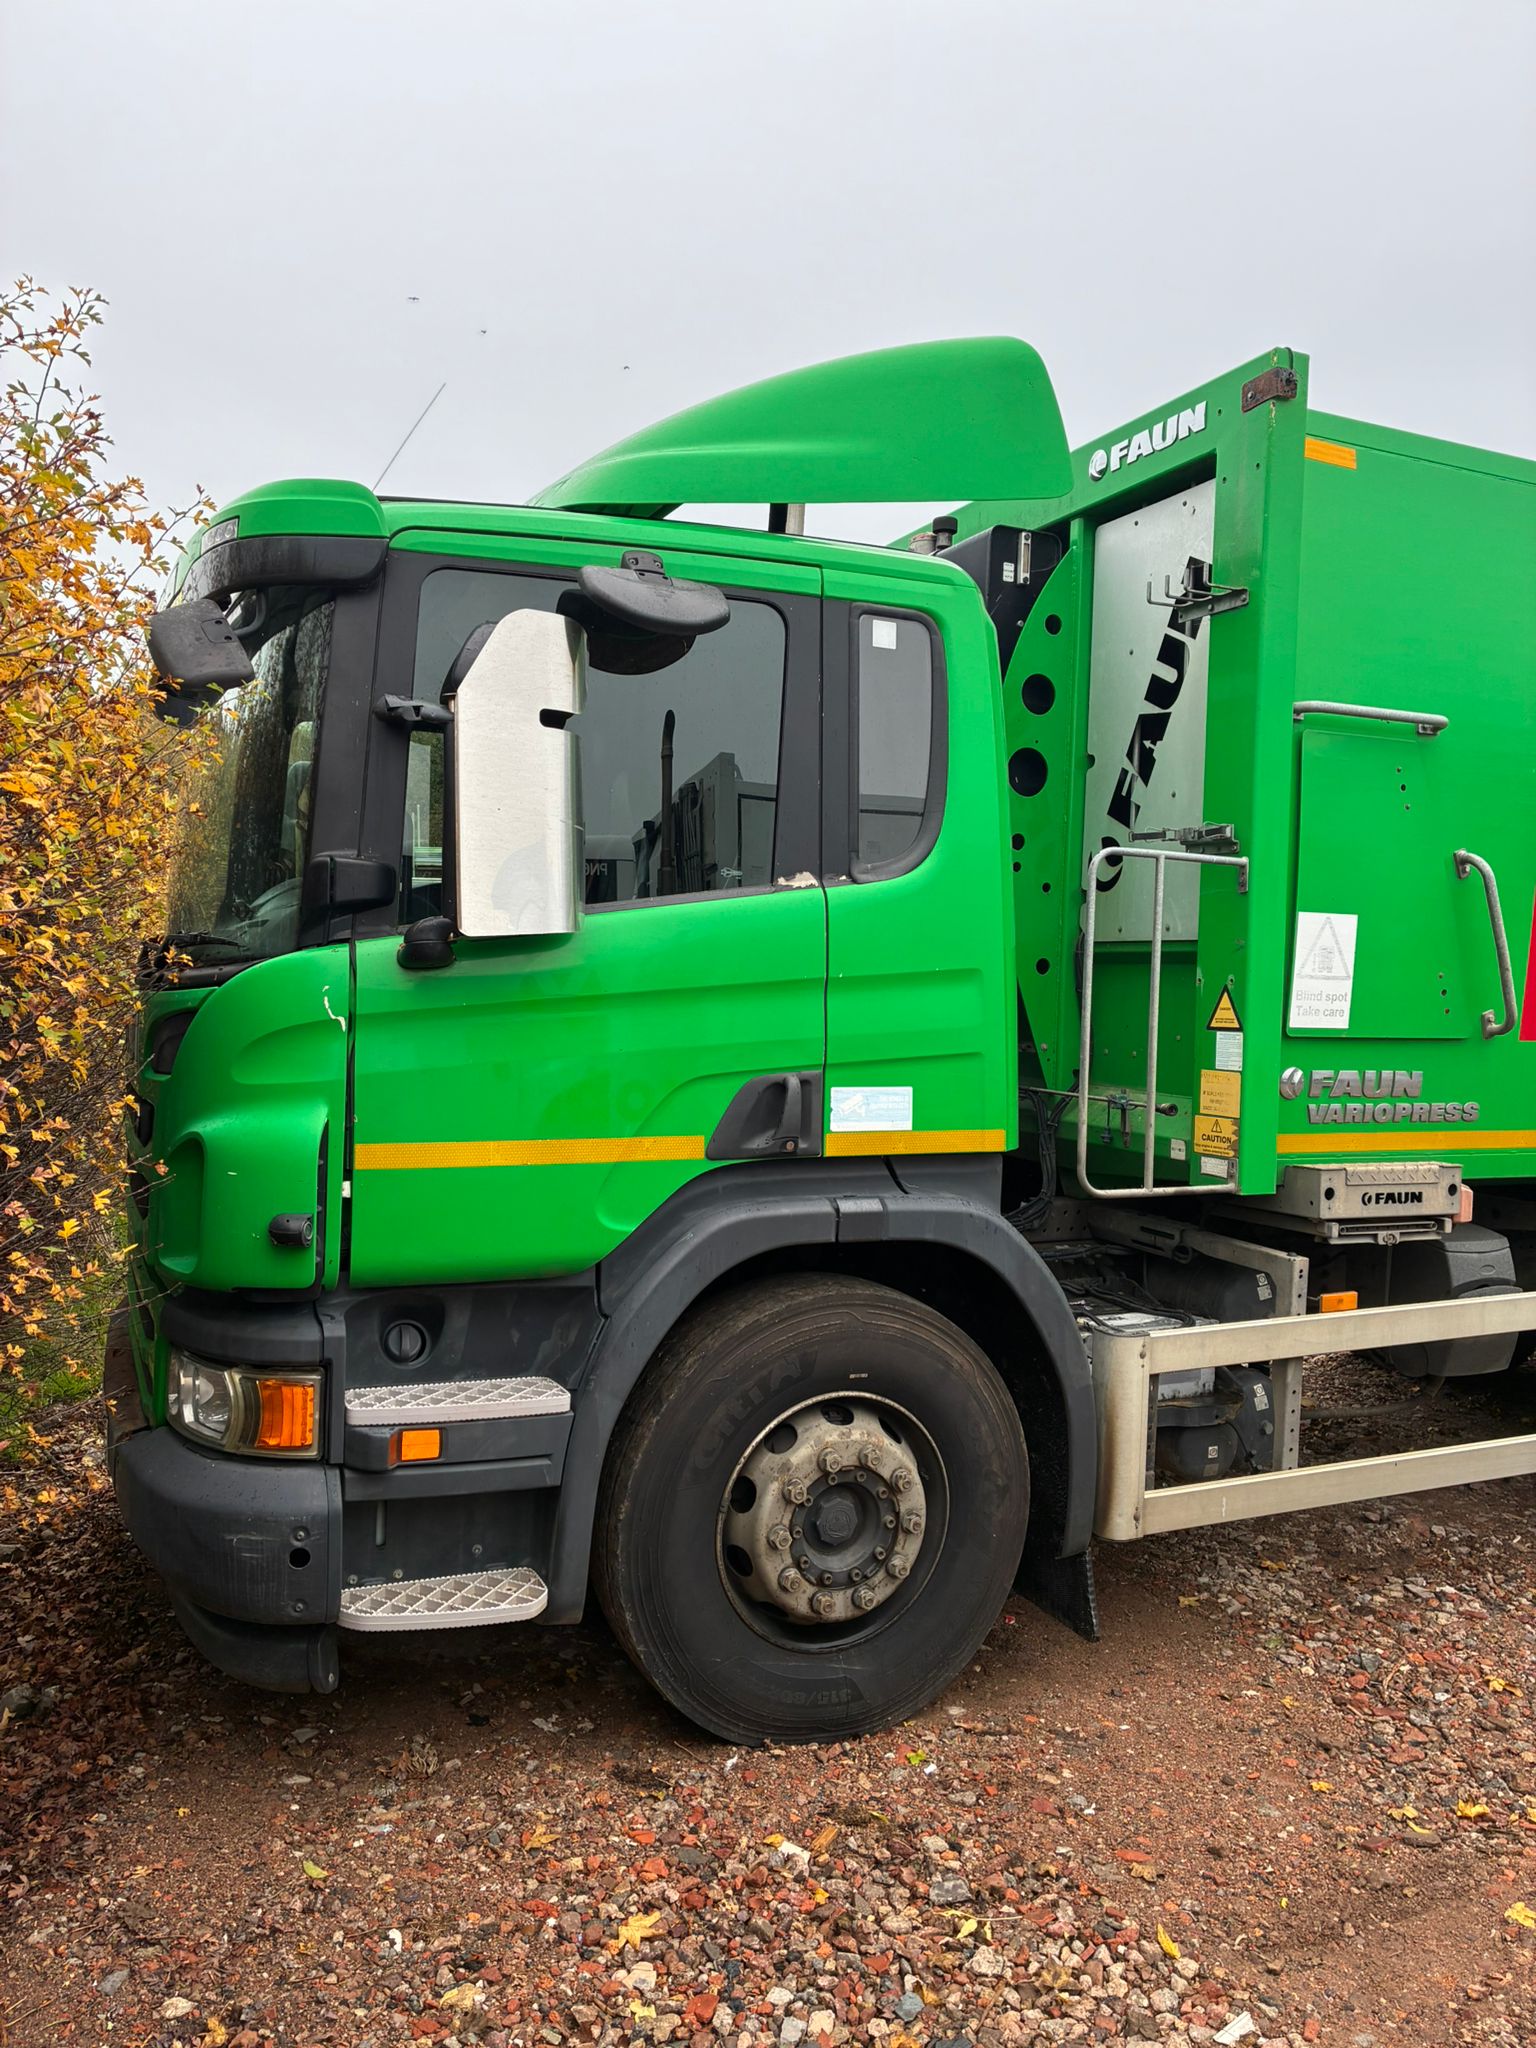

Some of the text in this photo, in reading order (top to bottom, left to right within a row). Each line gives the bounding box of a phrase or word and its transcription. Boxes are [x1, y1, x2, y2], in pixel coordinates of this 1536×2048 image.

[1110, 400, 1207, 472] FAUN
[1106, 555, 1213, 831] FAUN
[1296, 990, 1348, 1004] Blind spot
[1296, 1005, 1345, 1018] Take care
[1308, 1070, 1423, 1099] FAUN
[1307, 1102, 1480, 1124] VARIOPRESS
[1201, 1133, 1232, 1144] CAUTION
[1374, 1191, 1423, 1205] FAUN
